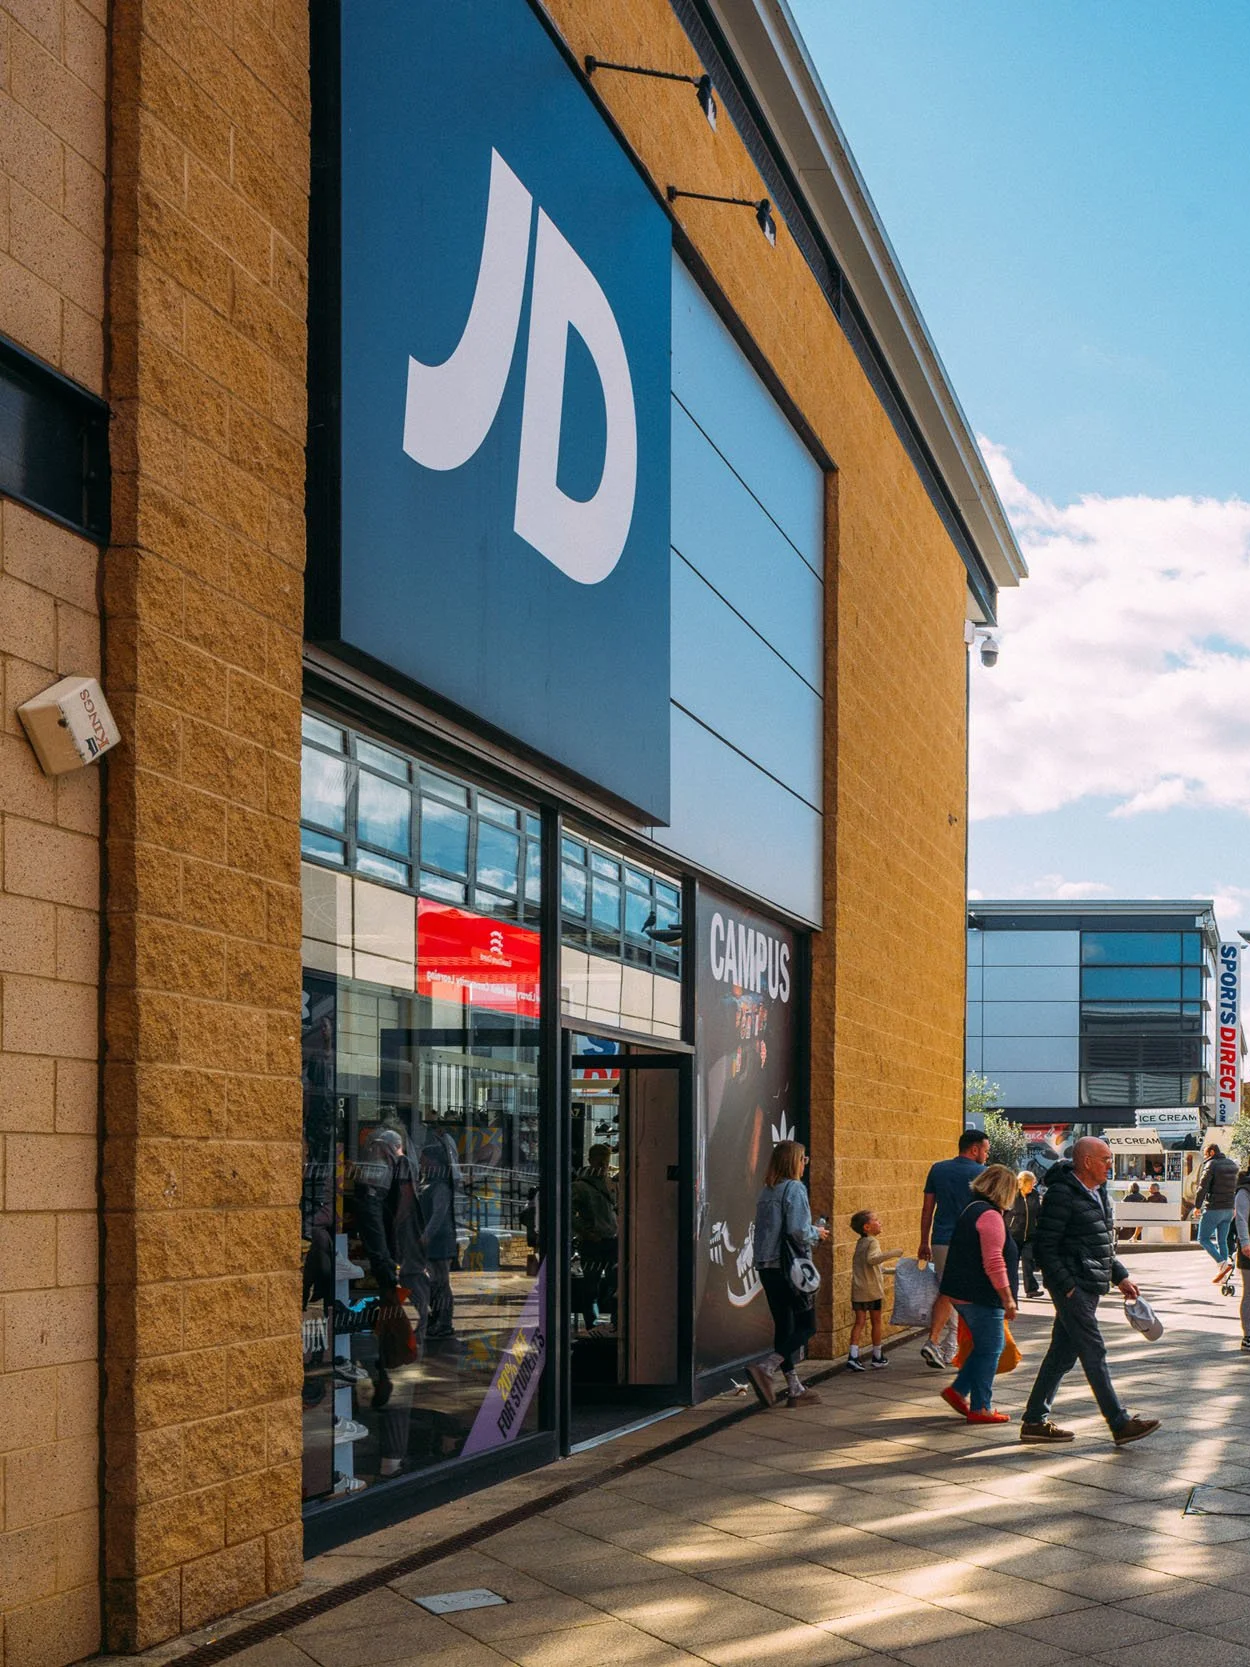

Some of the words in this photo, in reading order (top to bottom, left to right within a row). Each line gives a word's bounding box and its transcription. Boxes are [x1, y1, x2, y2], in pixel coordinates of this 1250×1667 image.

[402, 146, 638, 585] JD
[79, 688, 110, 751] KINGS
[710, 912, 790, 1003] CAMPUS
[1124, 1137, 1160, 1145] CREAM
[1139, 1114, 1156, 1123] ICE
[1158, 1113, 1197, 1122] CREAM
[497, 1404, 516, 1440] FOR
